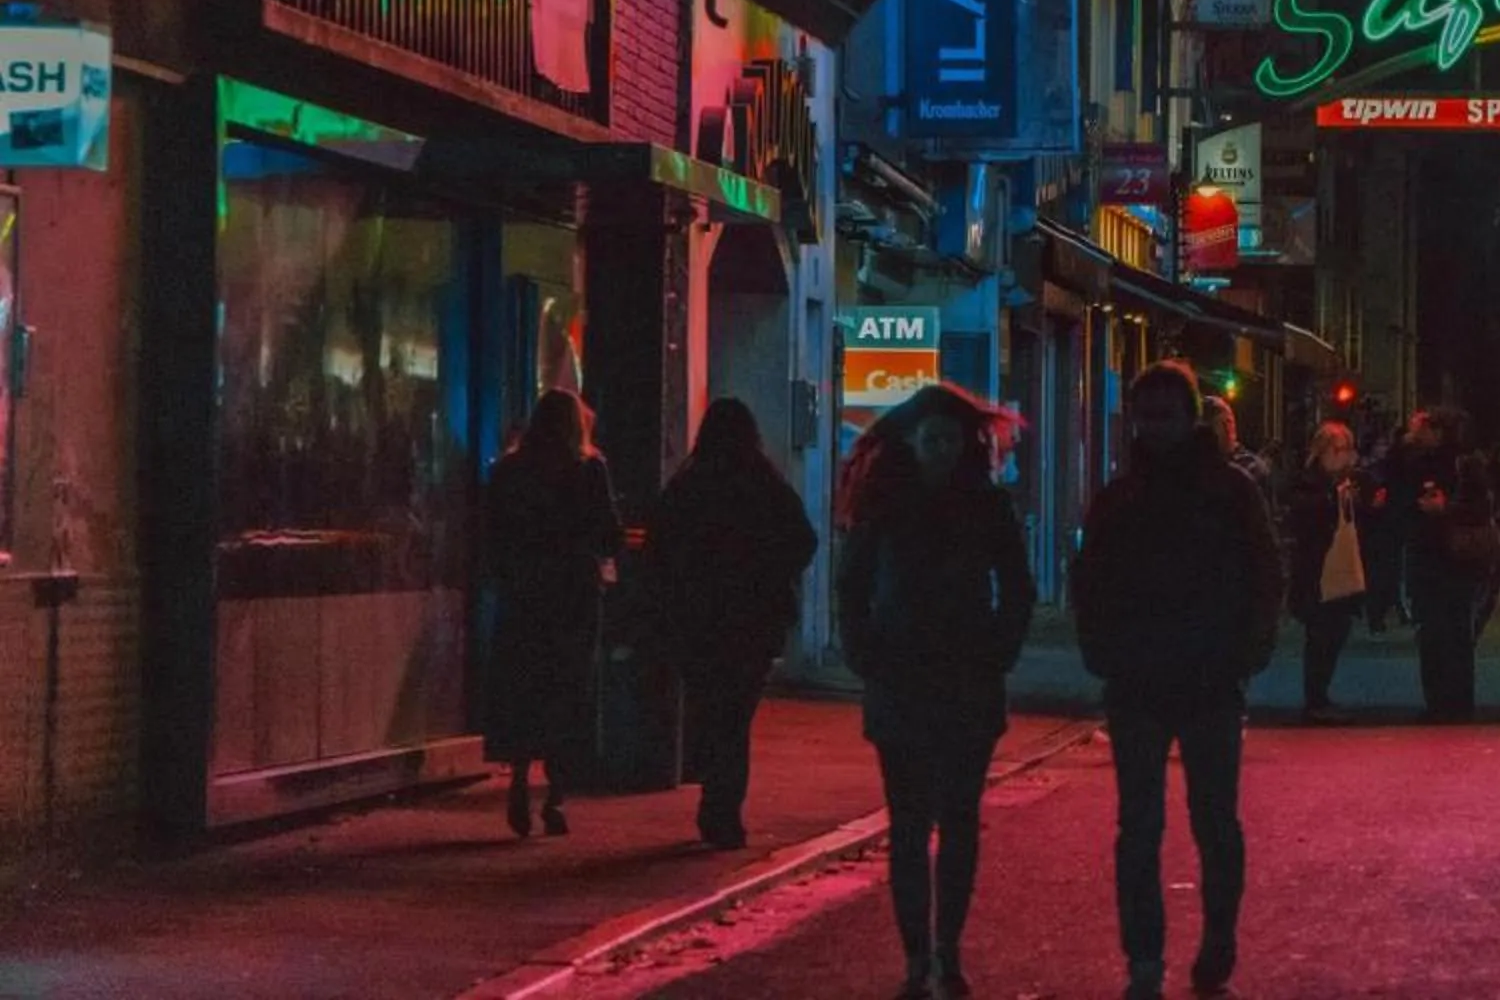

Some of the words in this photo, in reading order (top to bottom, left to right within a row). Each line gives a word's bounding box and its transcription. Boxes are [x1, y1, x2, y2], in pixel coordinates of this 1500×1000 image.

[1342, 99, 1437, 125] tipwin
[1114, 167, 1153, 195] 23
[857, 316, 925, 341] ATM
